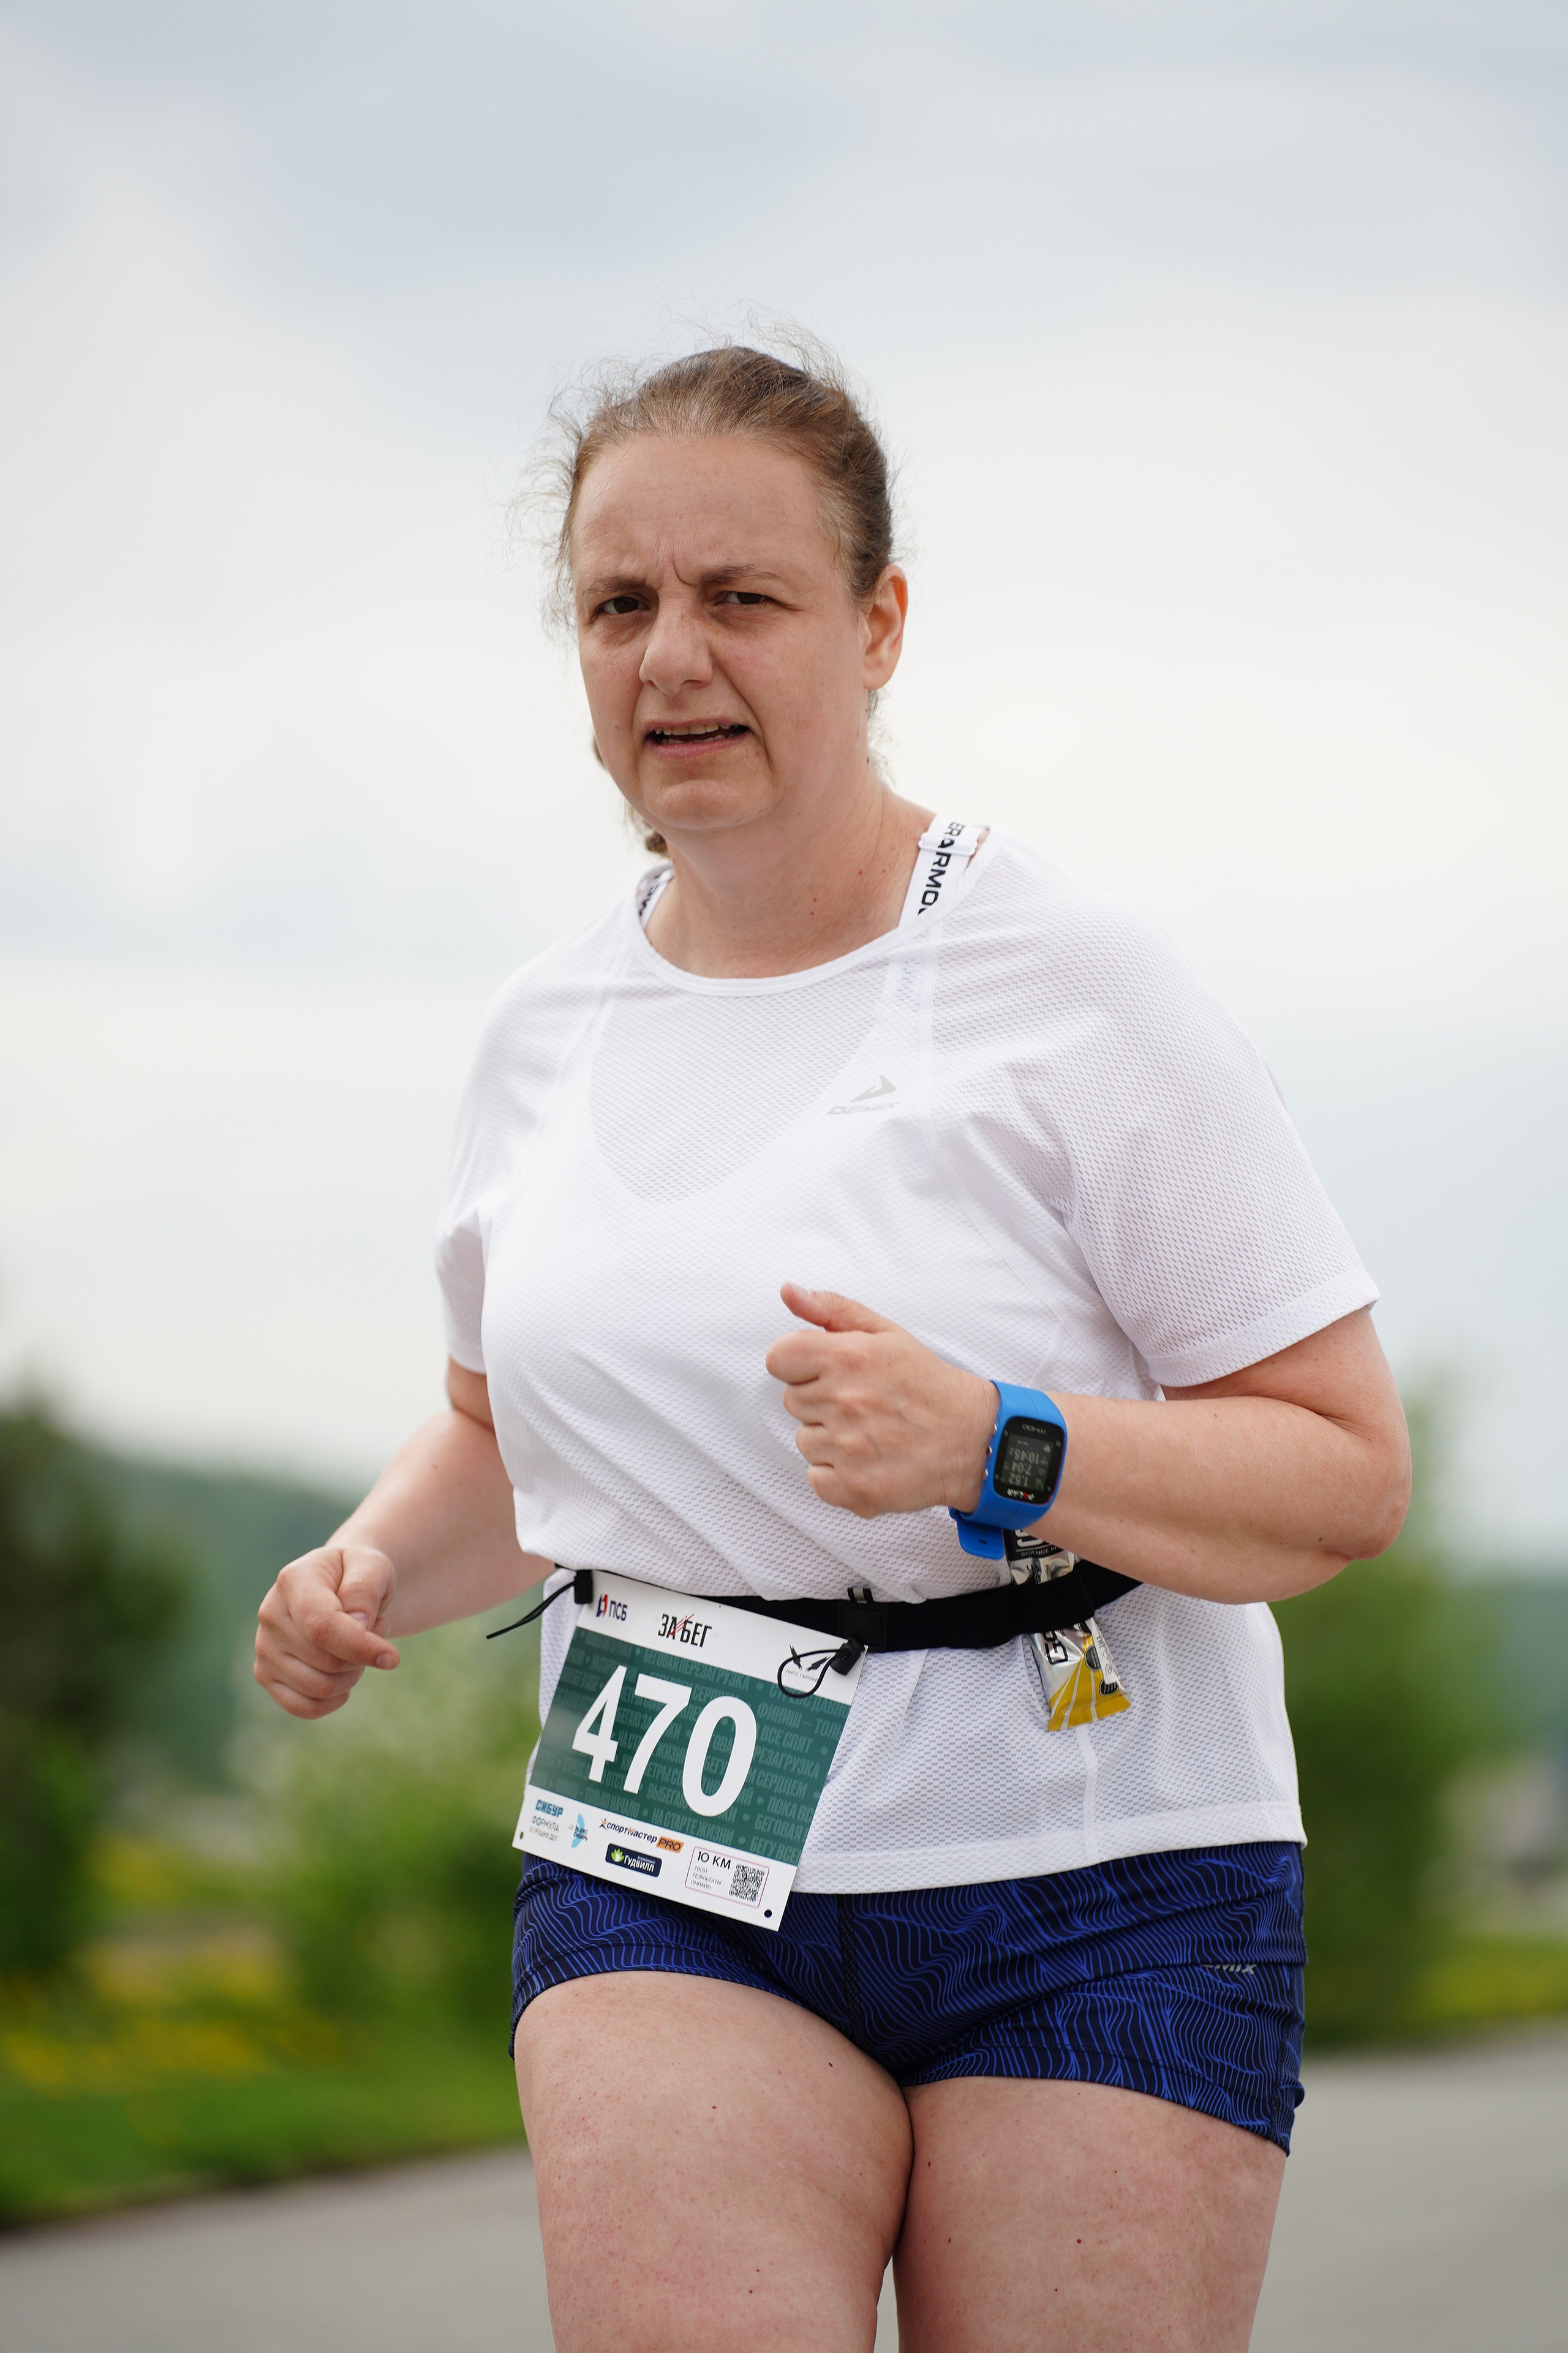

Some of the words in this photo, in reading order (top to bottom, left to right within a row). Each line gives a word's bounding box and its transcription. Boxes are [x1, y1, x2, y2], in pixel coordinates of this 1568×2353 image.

[1020, 1547, 1049, 1557] SCIENCE
[608, 1600, 628, 1621] ПСБ
[571, 1664, 758, 1818] 470
[759, 1724, 784, 1746] ВСЕ
[781, 1730, 814, 1754] СПЯТ
[754, 1769, 809, 1800] СЕРДЦЕМ
[535, 1799, 564, 1818] СИБУР
[766, 1795, 799, 1819] ПОКА
[650, 1807, 666, 1826] НА
[662, 1810, 699, 1836] СТАРТЕ
[695, 1819, 736, 1847] ЖИЗНИ
[753, 1813, 804, 1843] БЕГОВАЯ
[657, 1837, 682, 1852] PRO
[748, 1835, 777, 1859] БЕГУ
[696, 1850, 710, 1864] 10
